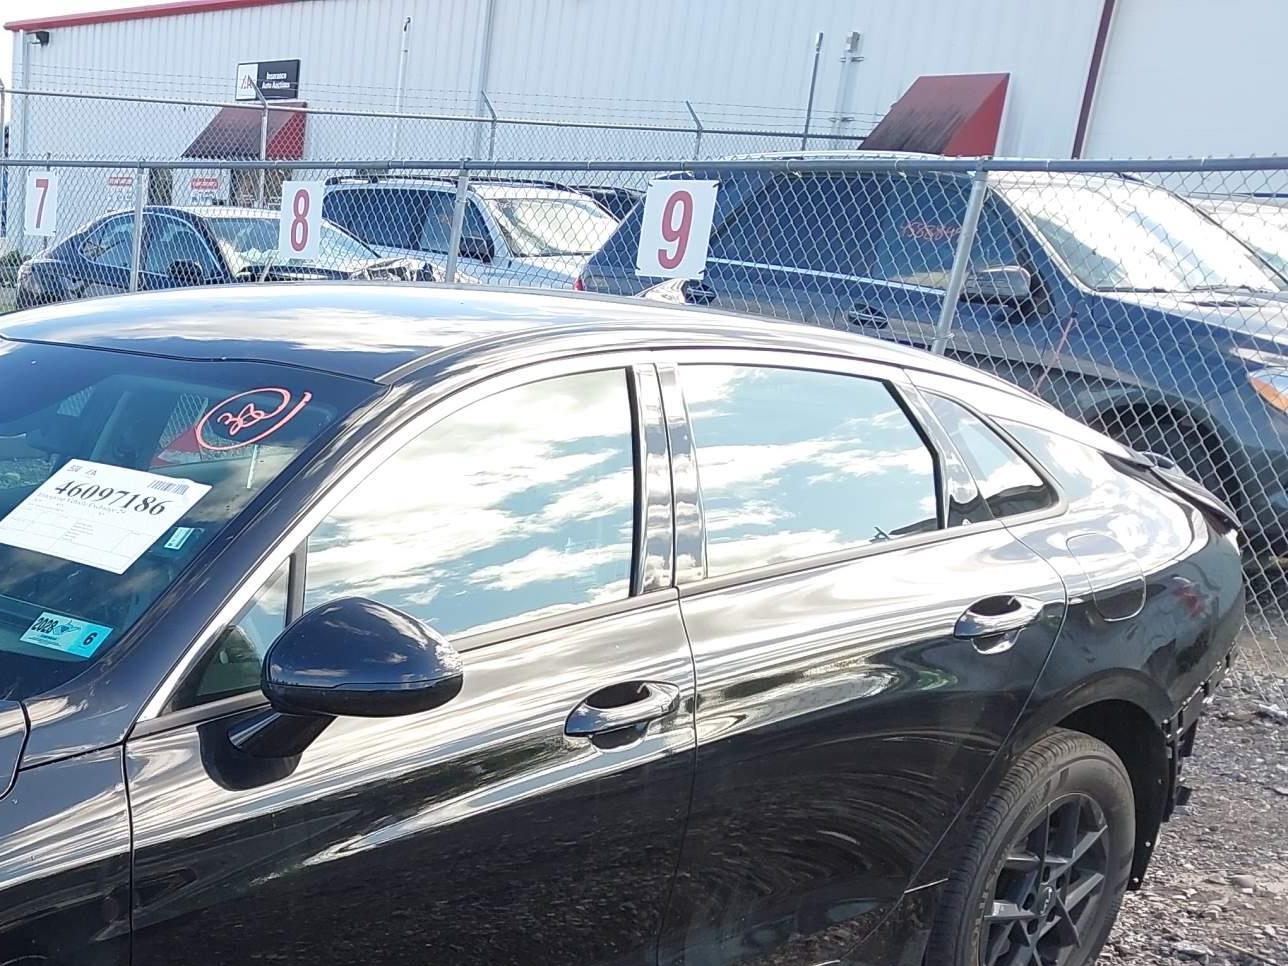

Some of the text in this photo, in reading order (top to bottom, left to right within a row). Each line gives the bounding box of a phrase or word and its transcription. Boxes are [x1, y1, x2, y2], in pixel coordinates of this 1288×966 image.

[261, 81, 272, 89] Auto
[35, 179, 49, 229] 7
[290, 189, 310, 252] 8
[657, 190, 694, 269] 9
[55, 480, 175, 516] 46097186
[83, 631, 99, 646] 6
